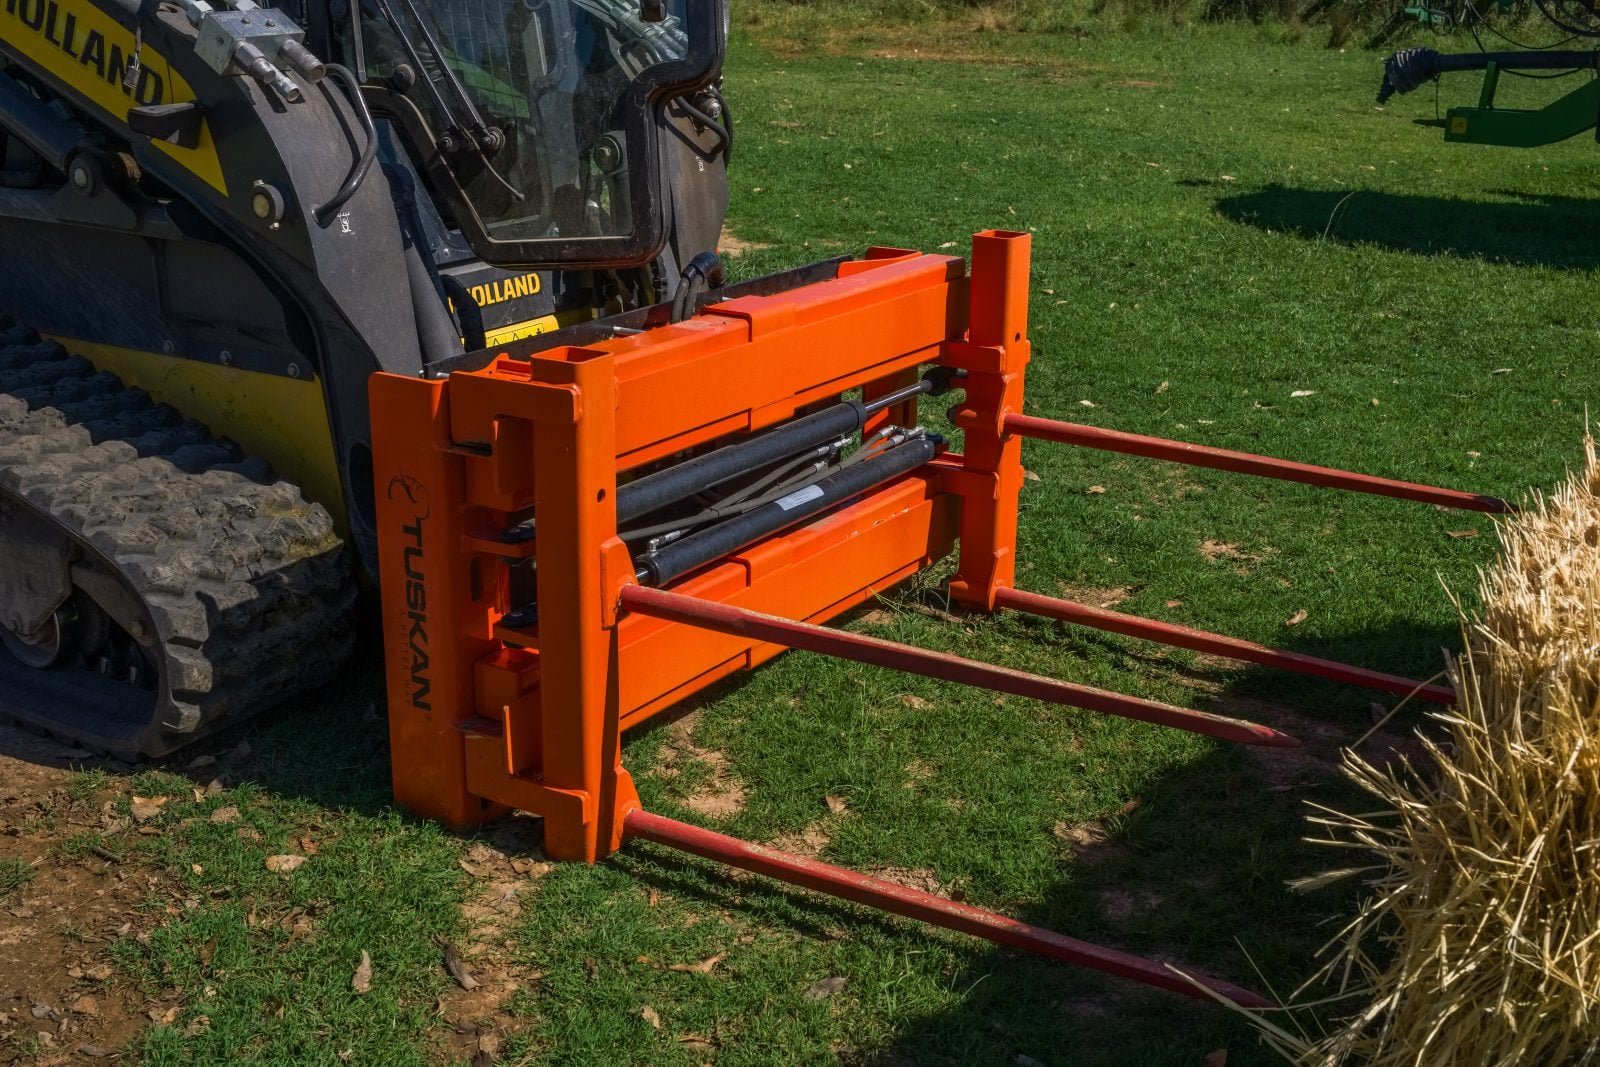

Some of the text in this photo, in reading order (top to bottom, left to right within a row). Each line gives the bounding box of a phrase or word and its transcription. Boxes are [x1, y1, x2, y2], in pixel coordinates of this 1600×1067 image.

[6, 0, 163, 106] OLLAND
[467, 273, 541, 307] OLLAND
[402, 517, 432, 712] TUSKAN
